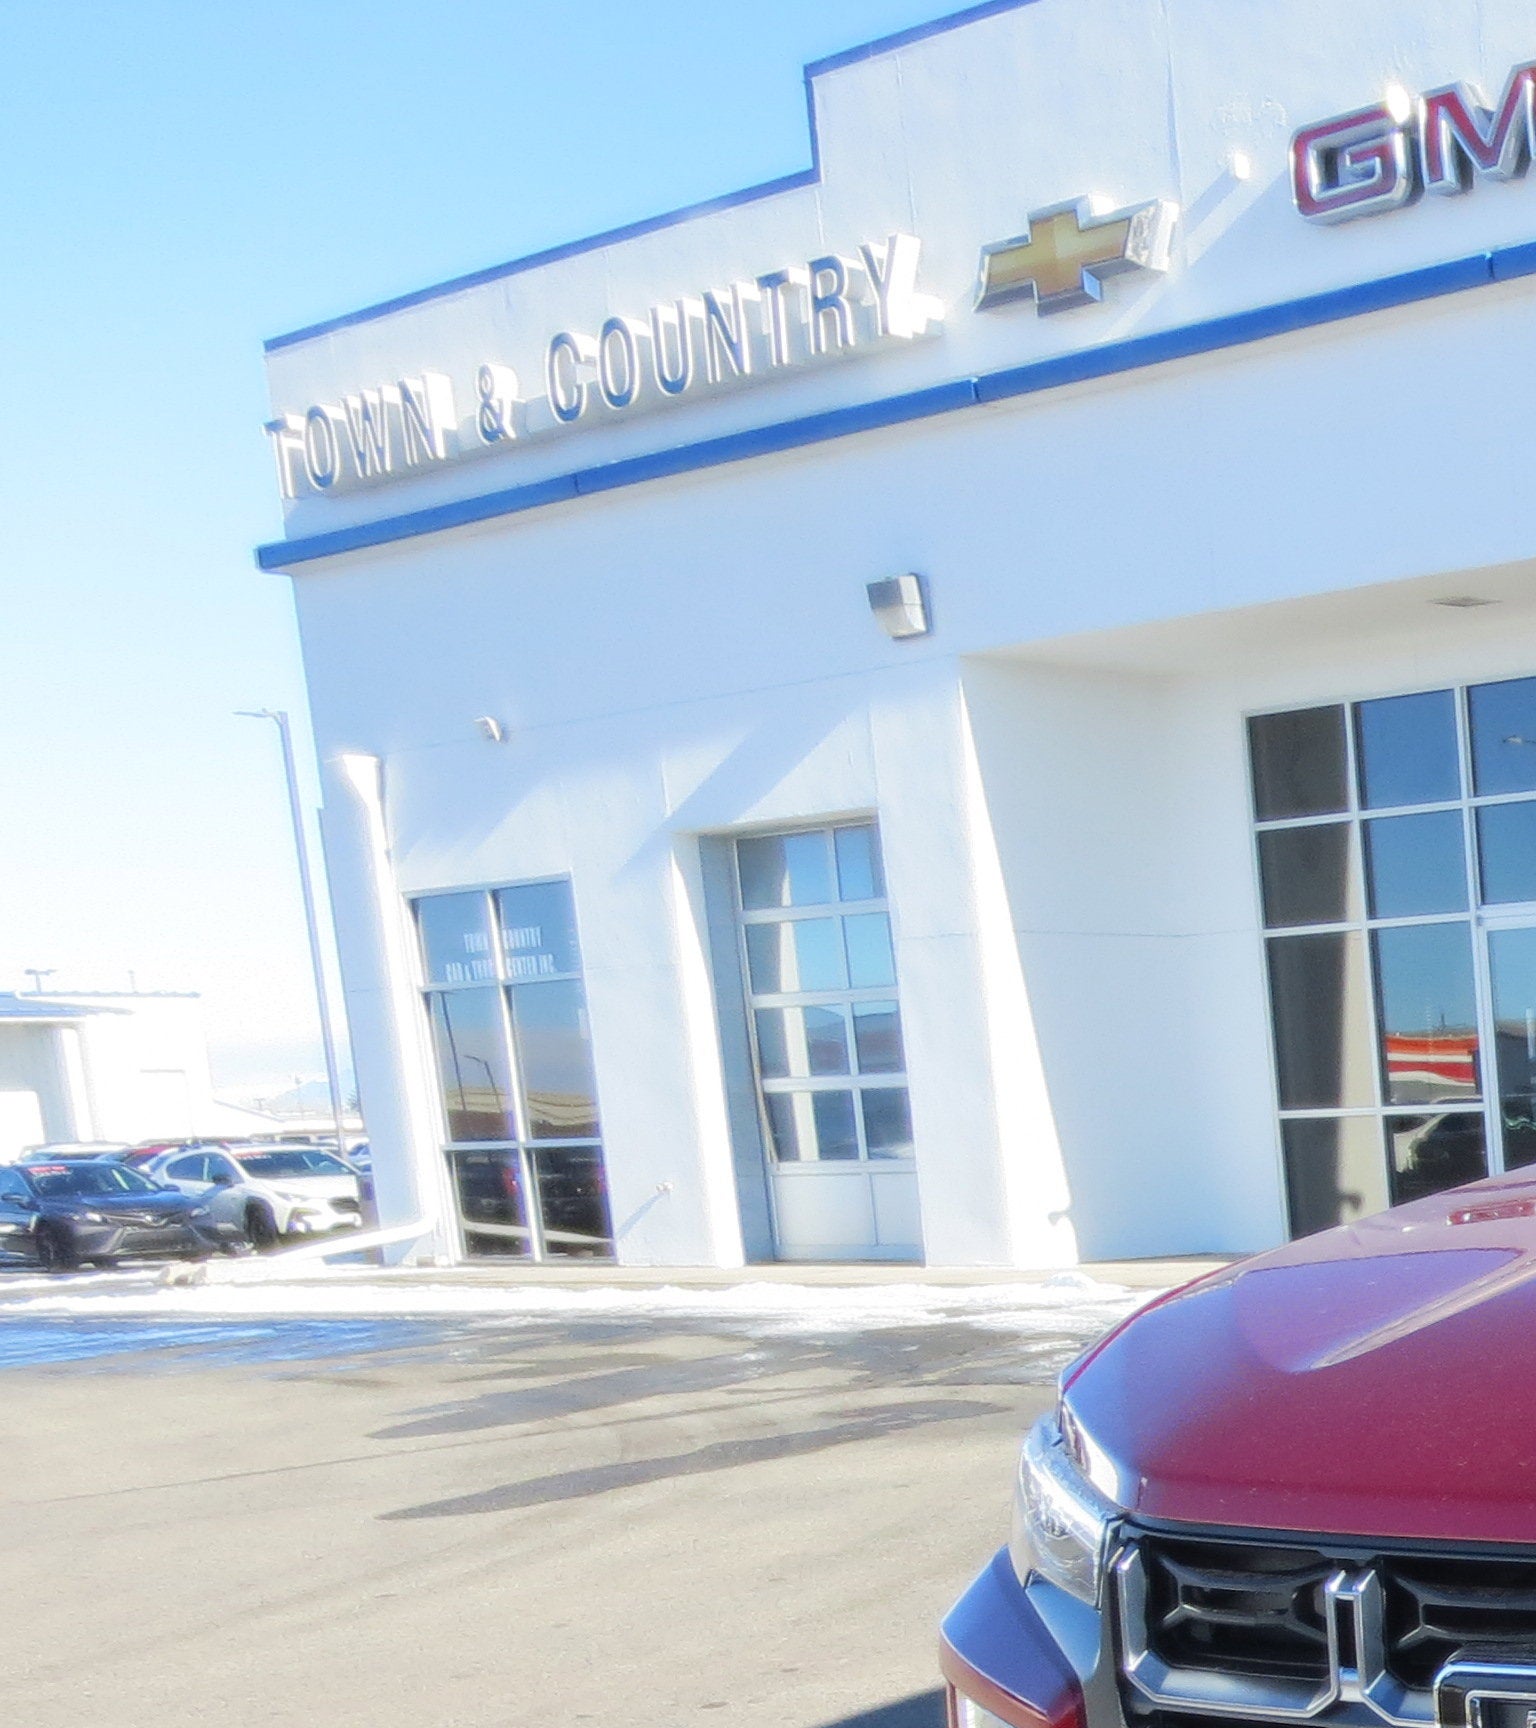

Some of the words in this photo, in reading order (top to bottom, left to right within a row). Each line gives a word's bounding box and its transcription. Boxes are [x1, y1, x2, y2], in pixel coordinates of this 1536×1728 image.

[263, 373, 449, 498] TOWN
[475, 361, 516, 446] &
[545, 234, 922, 424] COUNTRY
